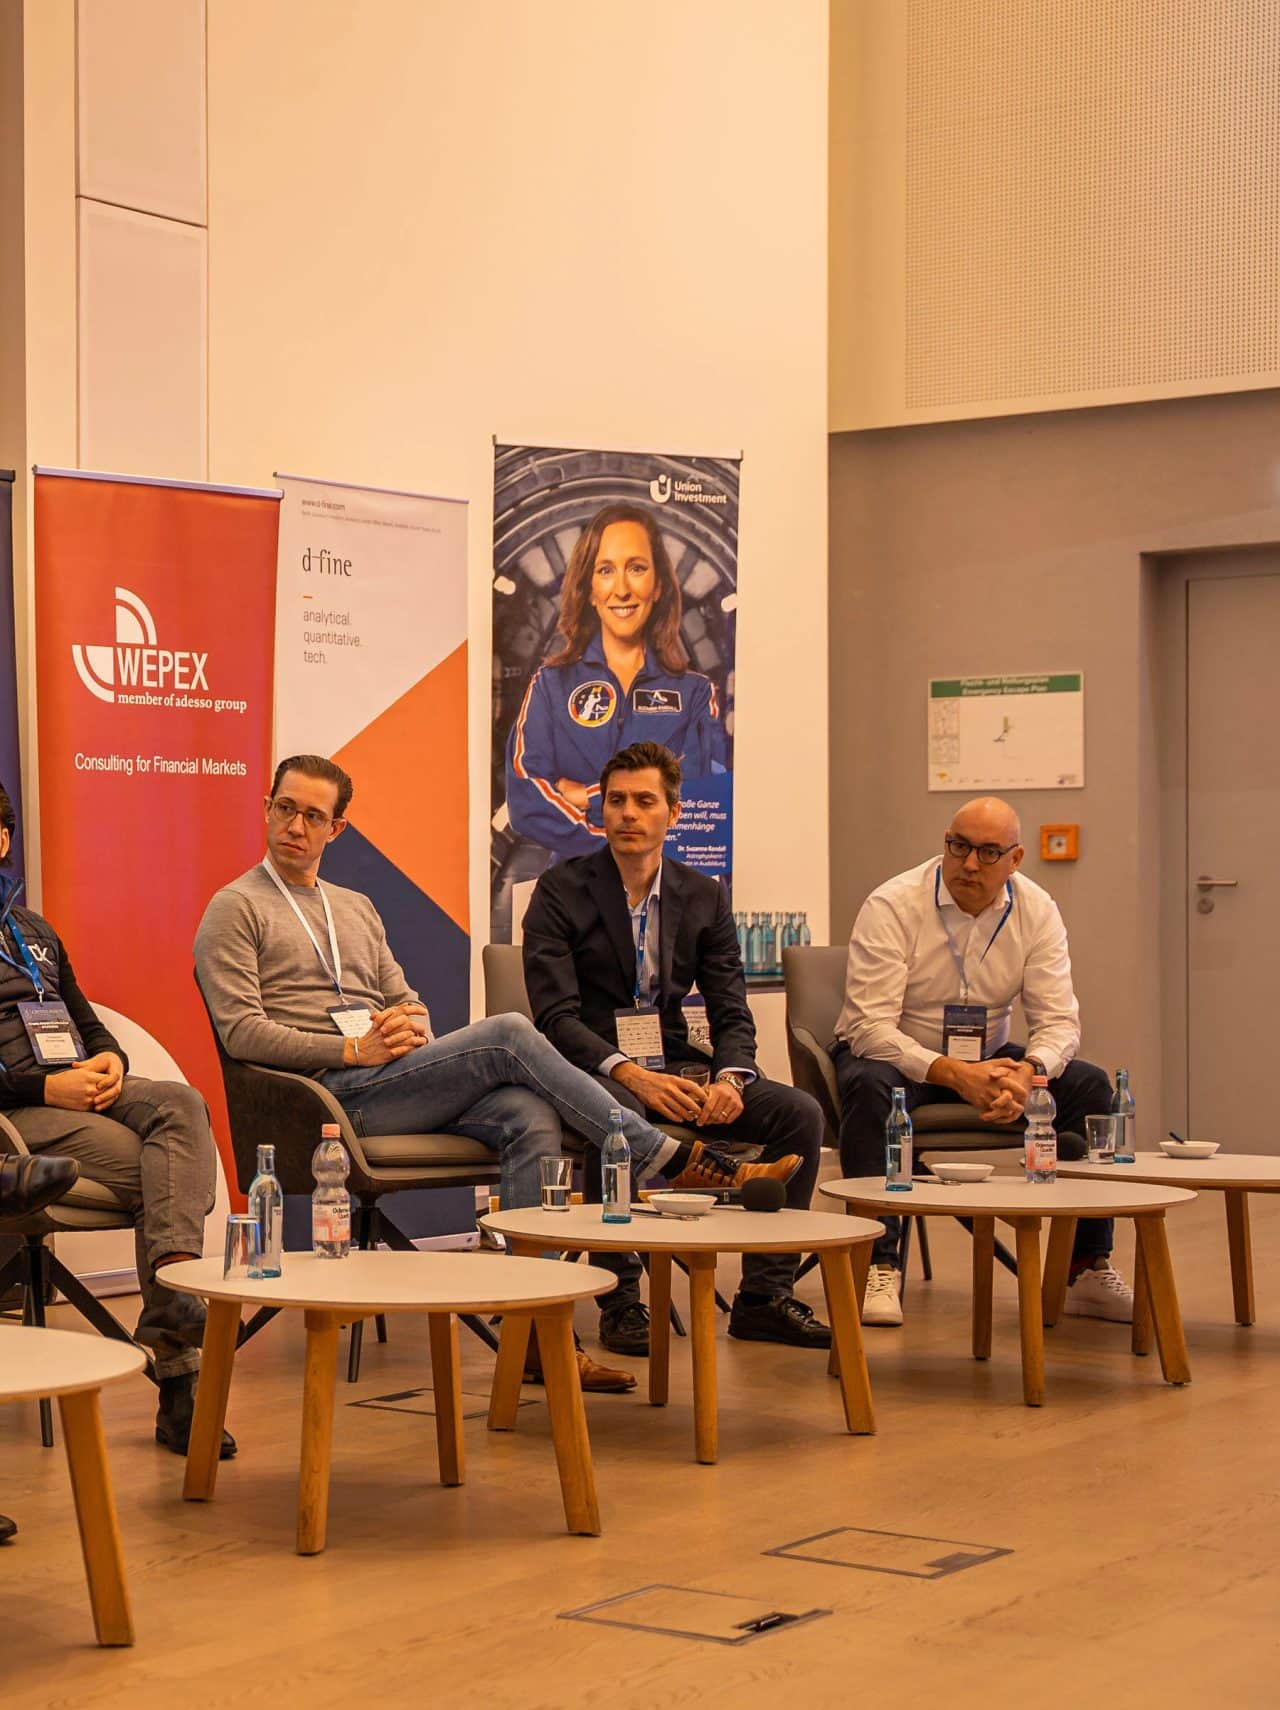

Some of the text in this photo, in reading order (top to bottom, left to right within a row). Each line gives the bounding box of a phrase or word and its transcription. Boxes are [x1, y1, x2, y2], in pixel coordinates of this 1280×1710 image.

[674, 480, 702, 492] Union
[674, 491, 727, 504] Investment
[116, 647, 209, 691] WEPEX
[117, 692, 248, 714] member of adesso group
[74, 752, 247, 776] Consulting for Financial Markets
[697, 799, 720, 809] Ganze
